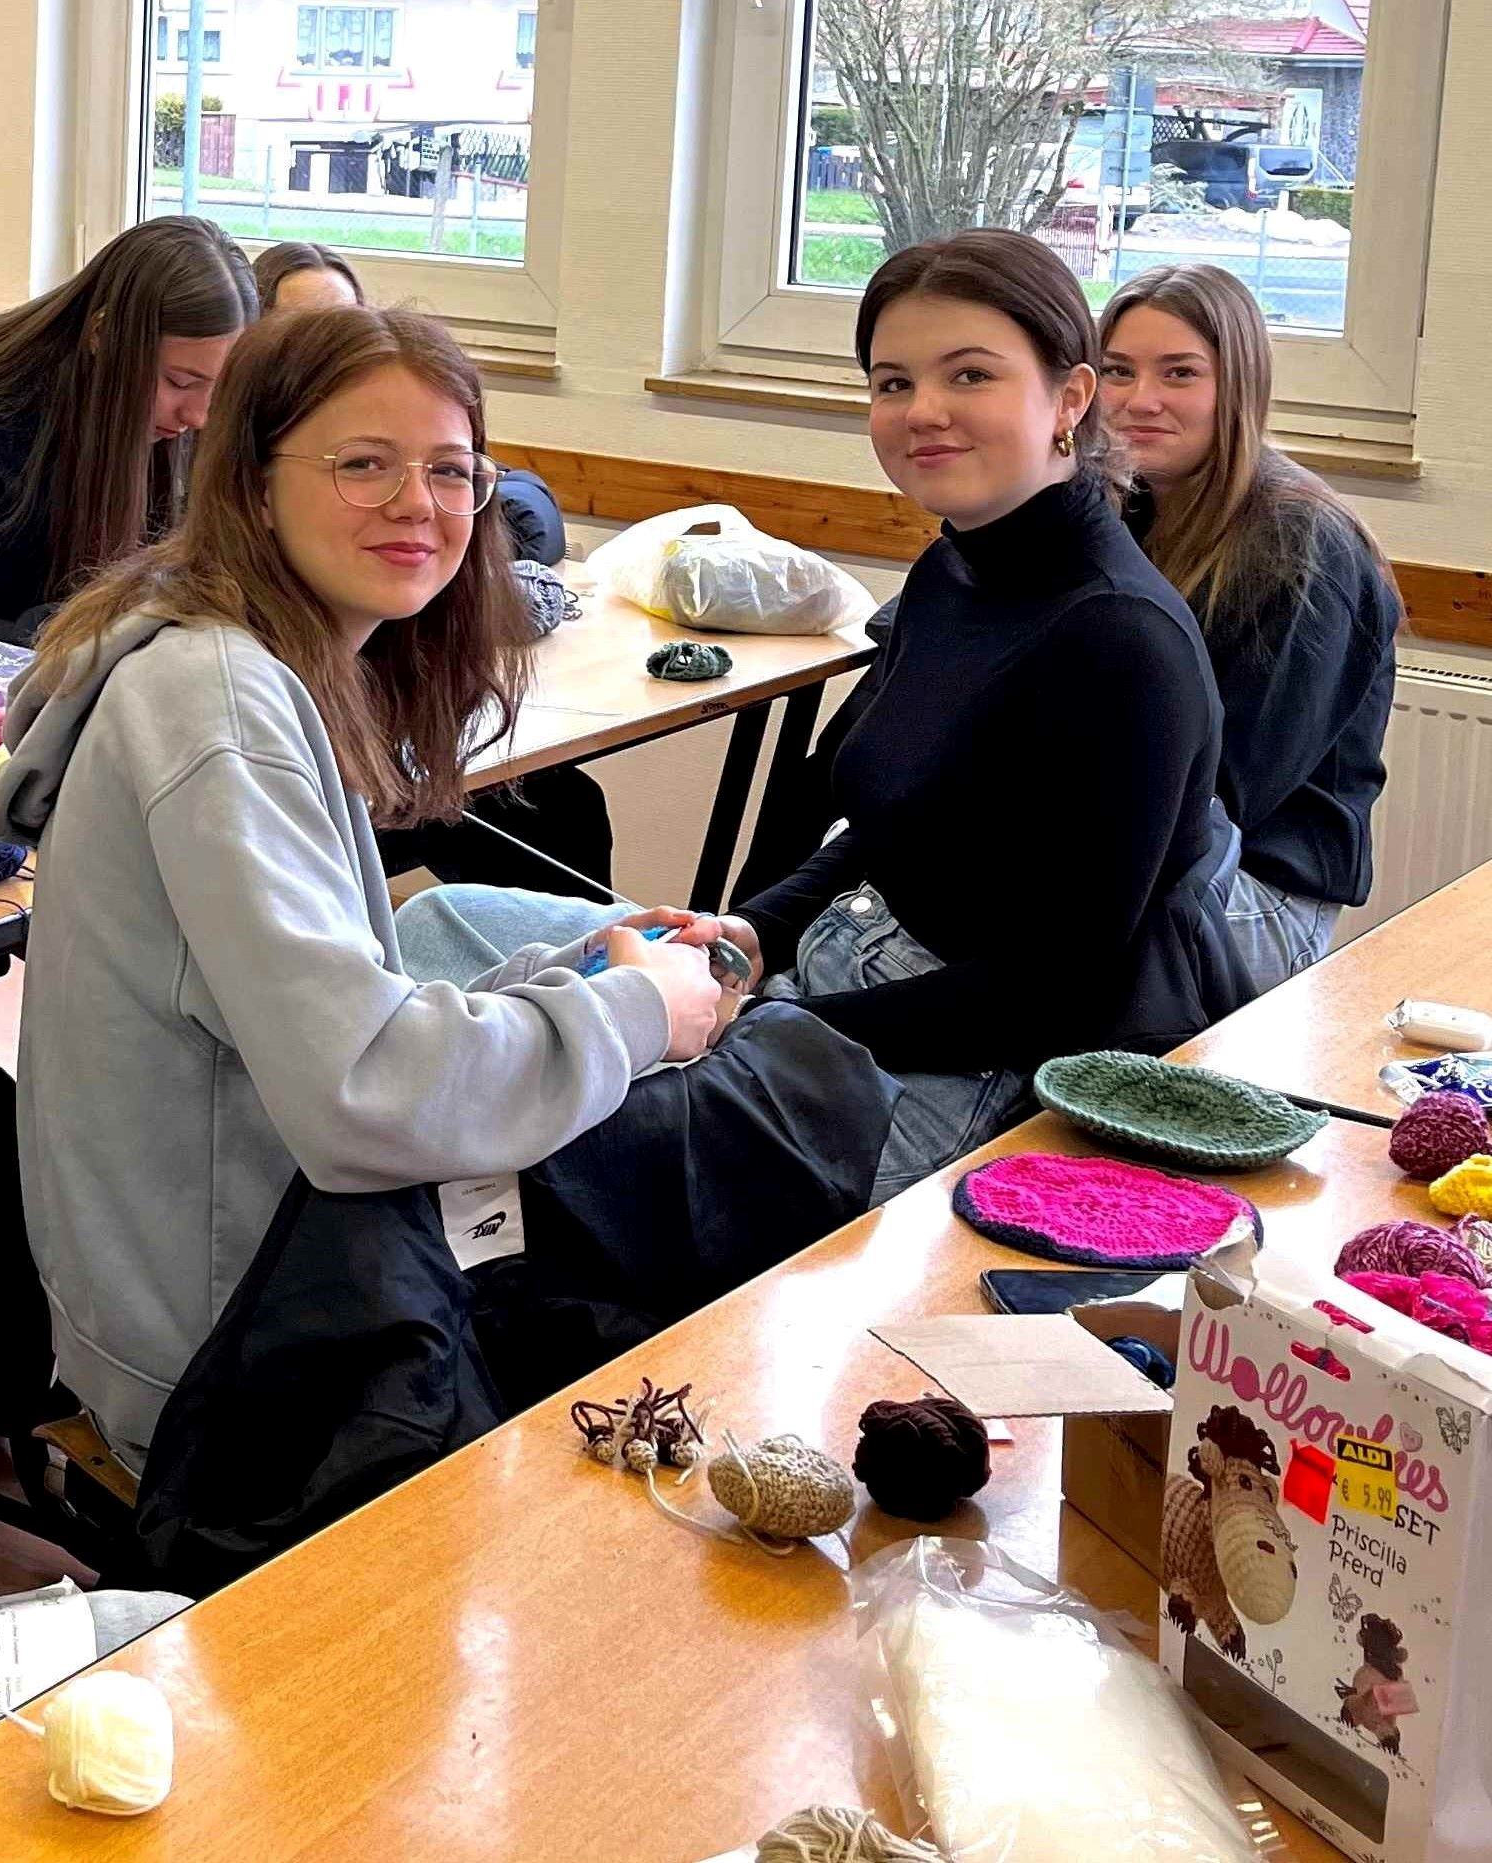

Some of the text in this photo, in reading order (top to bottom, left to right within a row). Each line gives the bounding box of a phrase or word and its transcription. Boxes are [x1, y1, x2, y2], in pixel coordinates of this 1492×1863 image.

[1341, 1443, 1388, 1468] ALDI
[1341, 1477, 1393, 1513] € 5.99
[1331, 1514, 1407, 1575] Priscilla
[1380, 1504, 1442, 1546] SET
[1328, 1540, 1384, 1588] Pferd
